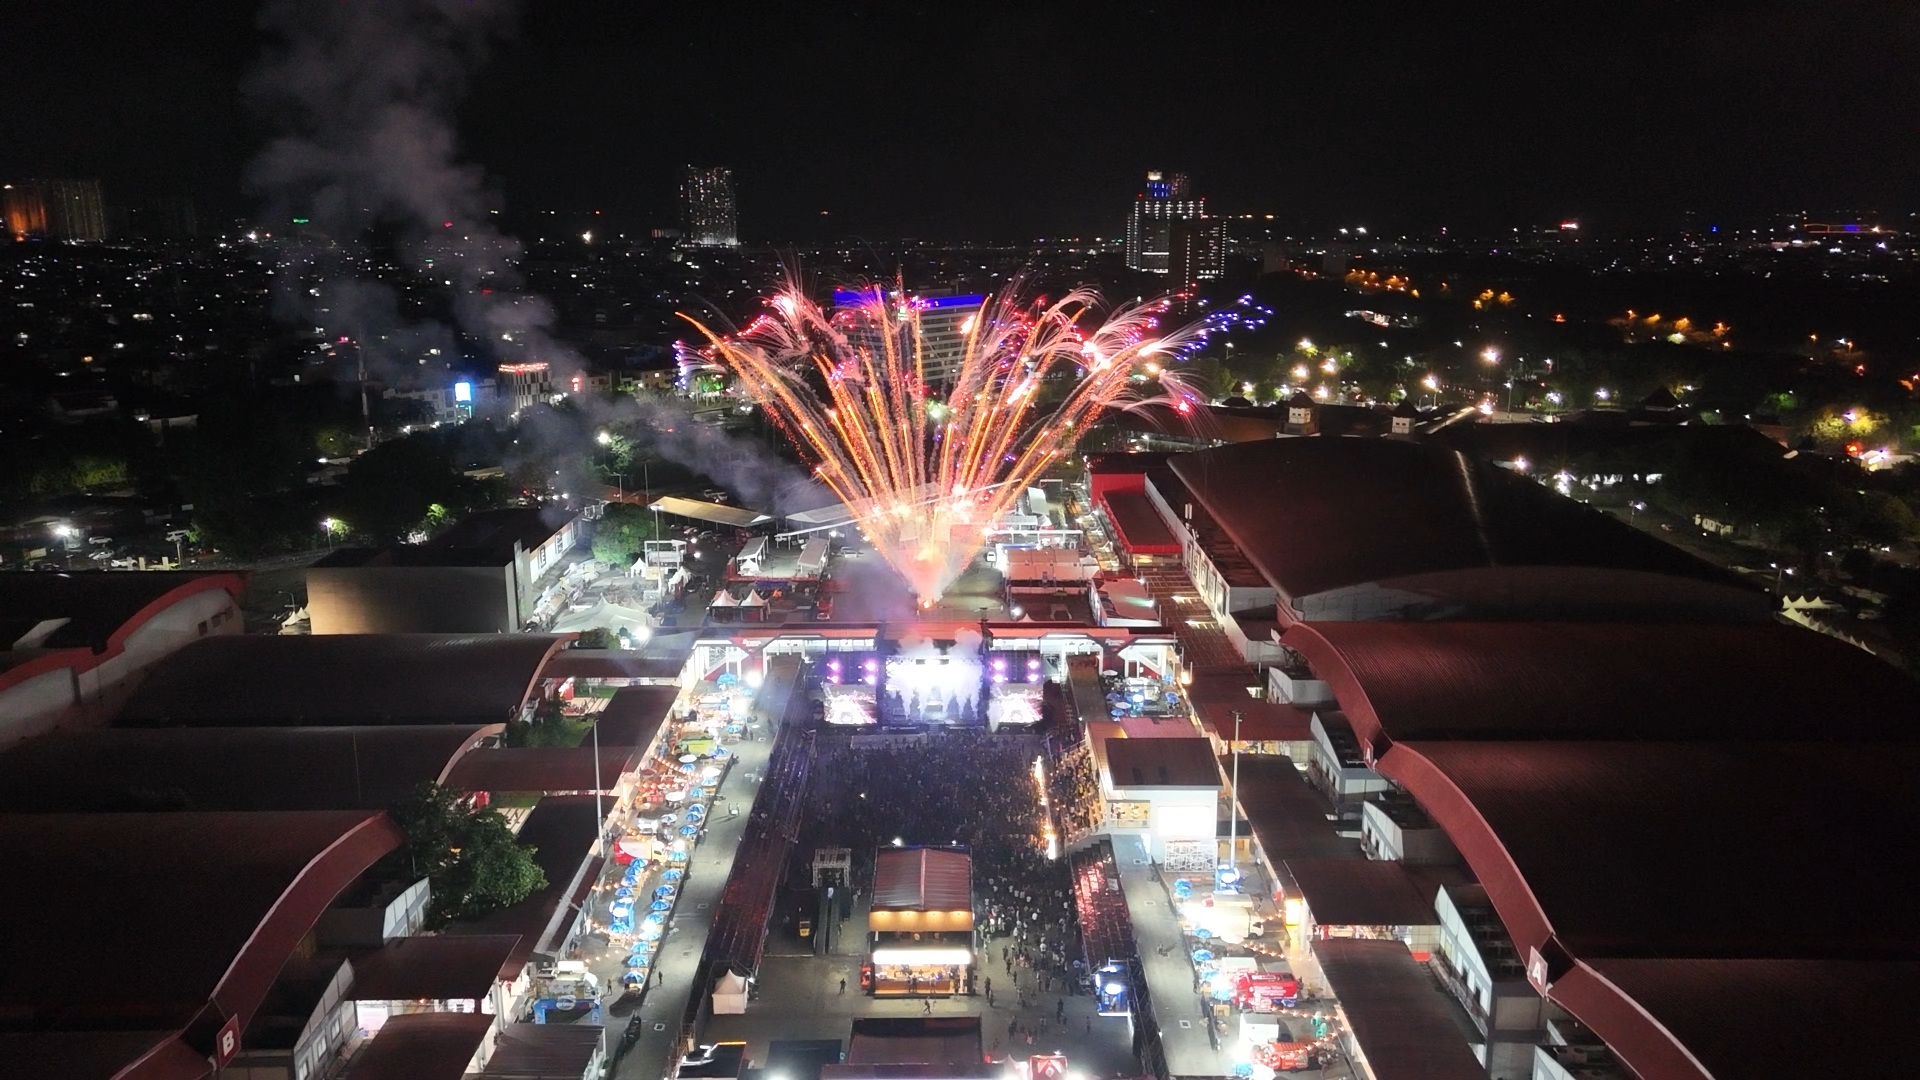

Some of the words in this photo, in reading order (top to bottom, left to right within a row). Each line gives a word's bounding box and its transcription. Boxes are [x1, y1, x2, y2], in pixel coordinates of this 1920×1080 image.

[1365, 747, 1371, 764] A
[1532, 961, 1542, 986] A
[222, 1030, 235, 1057] B
